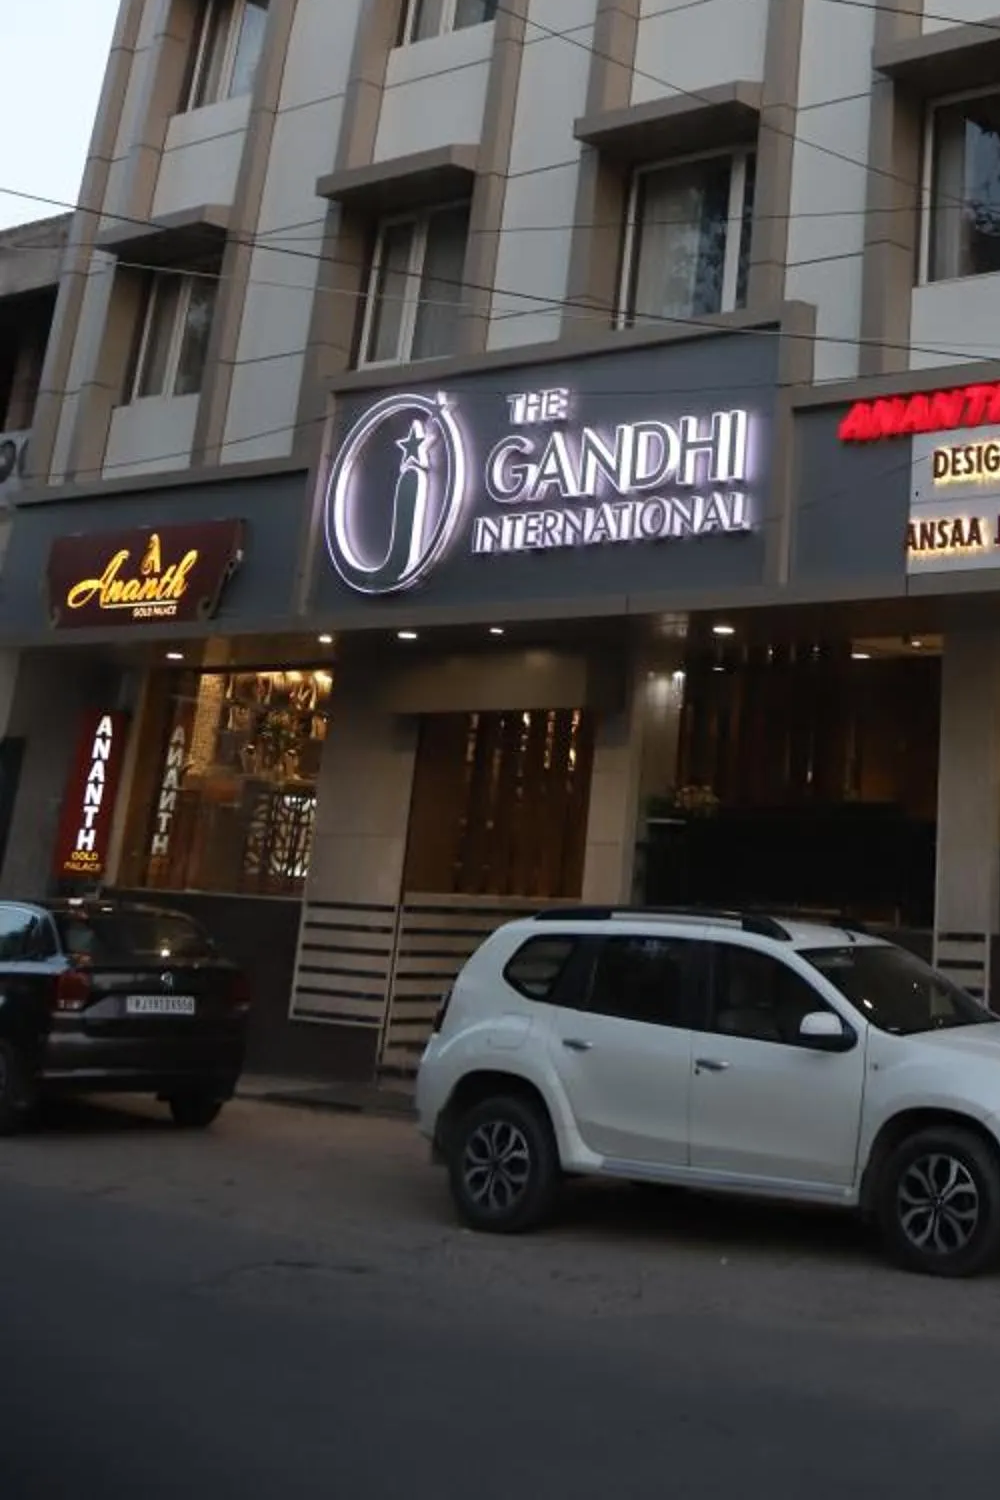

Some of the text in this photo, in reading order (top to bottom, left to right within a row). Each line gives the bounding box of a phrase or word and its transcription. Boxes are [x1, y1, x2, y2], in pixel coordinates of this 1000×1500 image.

[507, 388, 569, 424] THE
[485, 409, 748, 503] GANDHI
[472, 492, 752, 553] INTERNATIONAL
[67, 549, 199, 609] Ananth
[76, 715, 113, 851] ANANTH
[71, 851, 98, 861] GOLD
